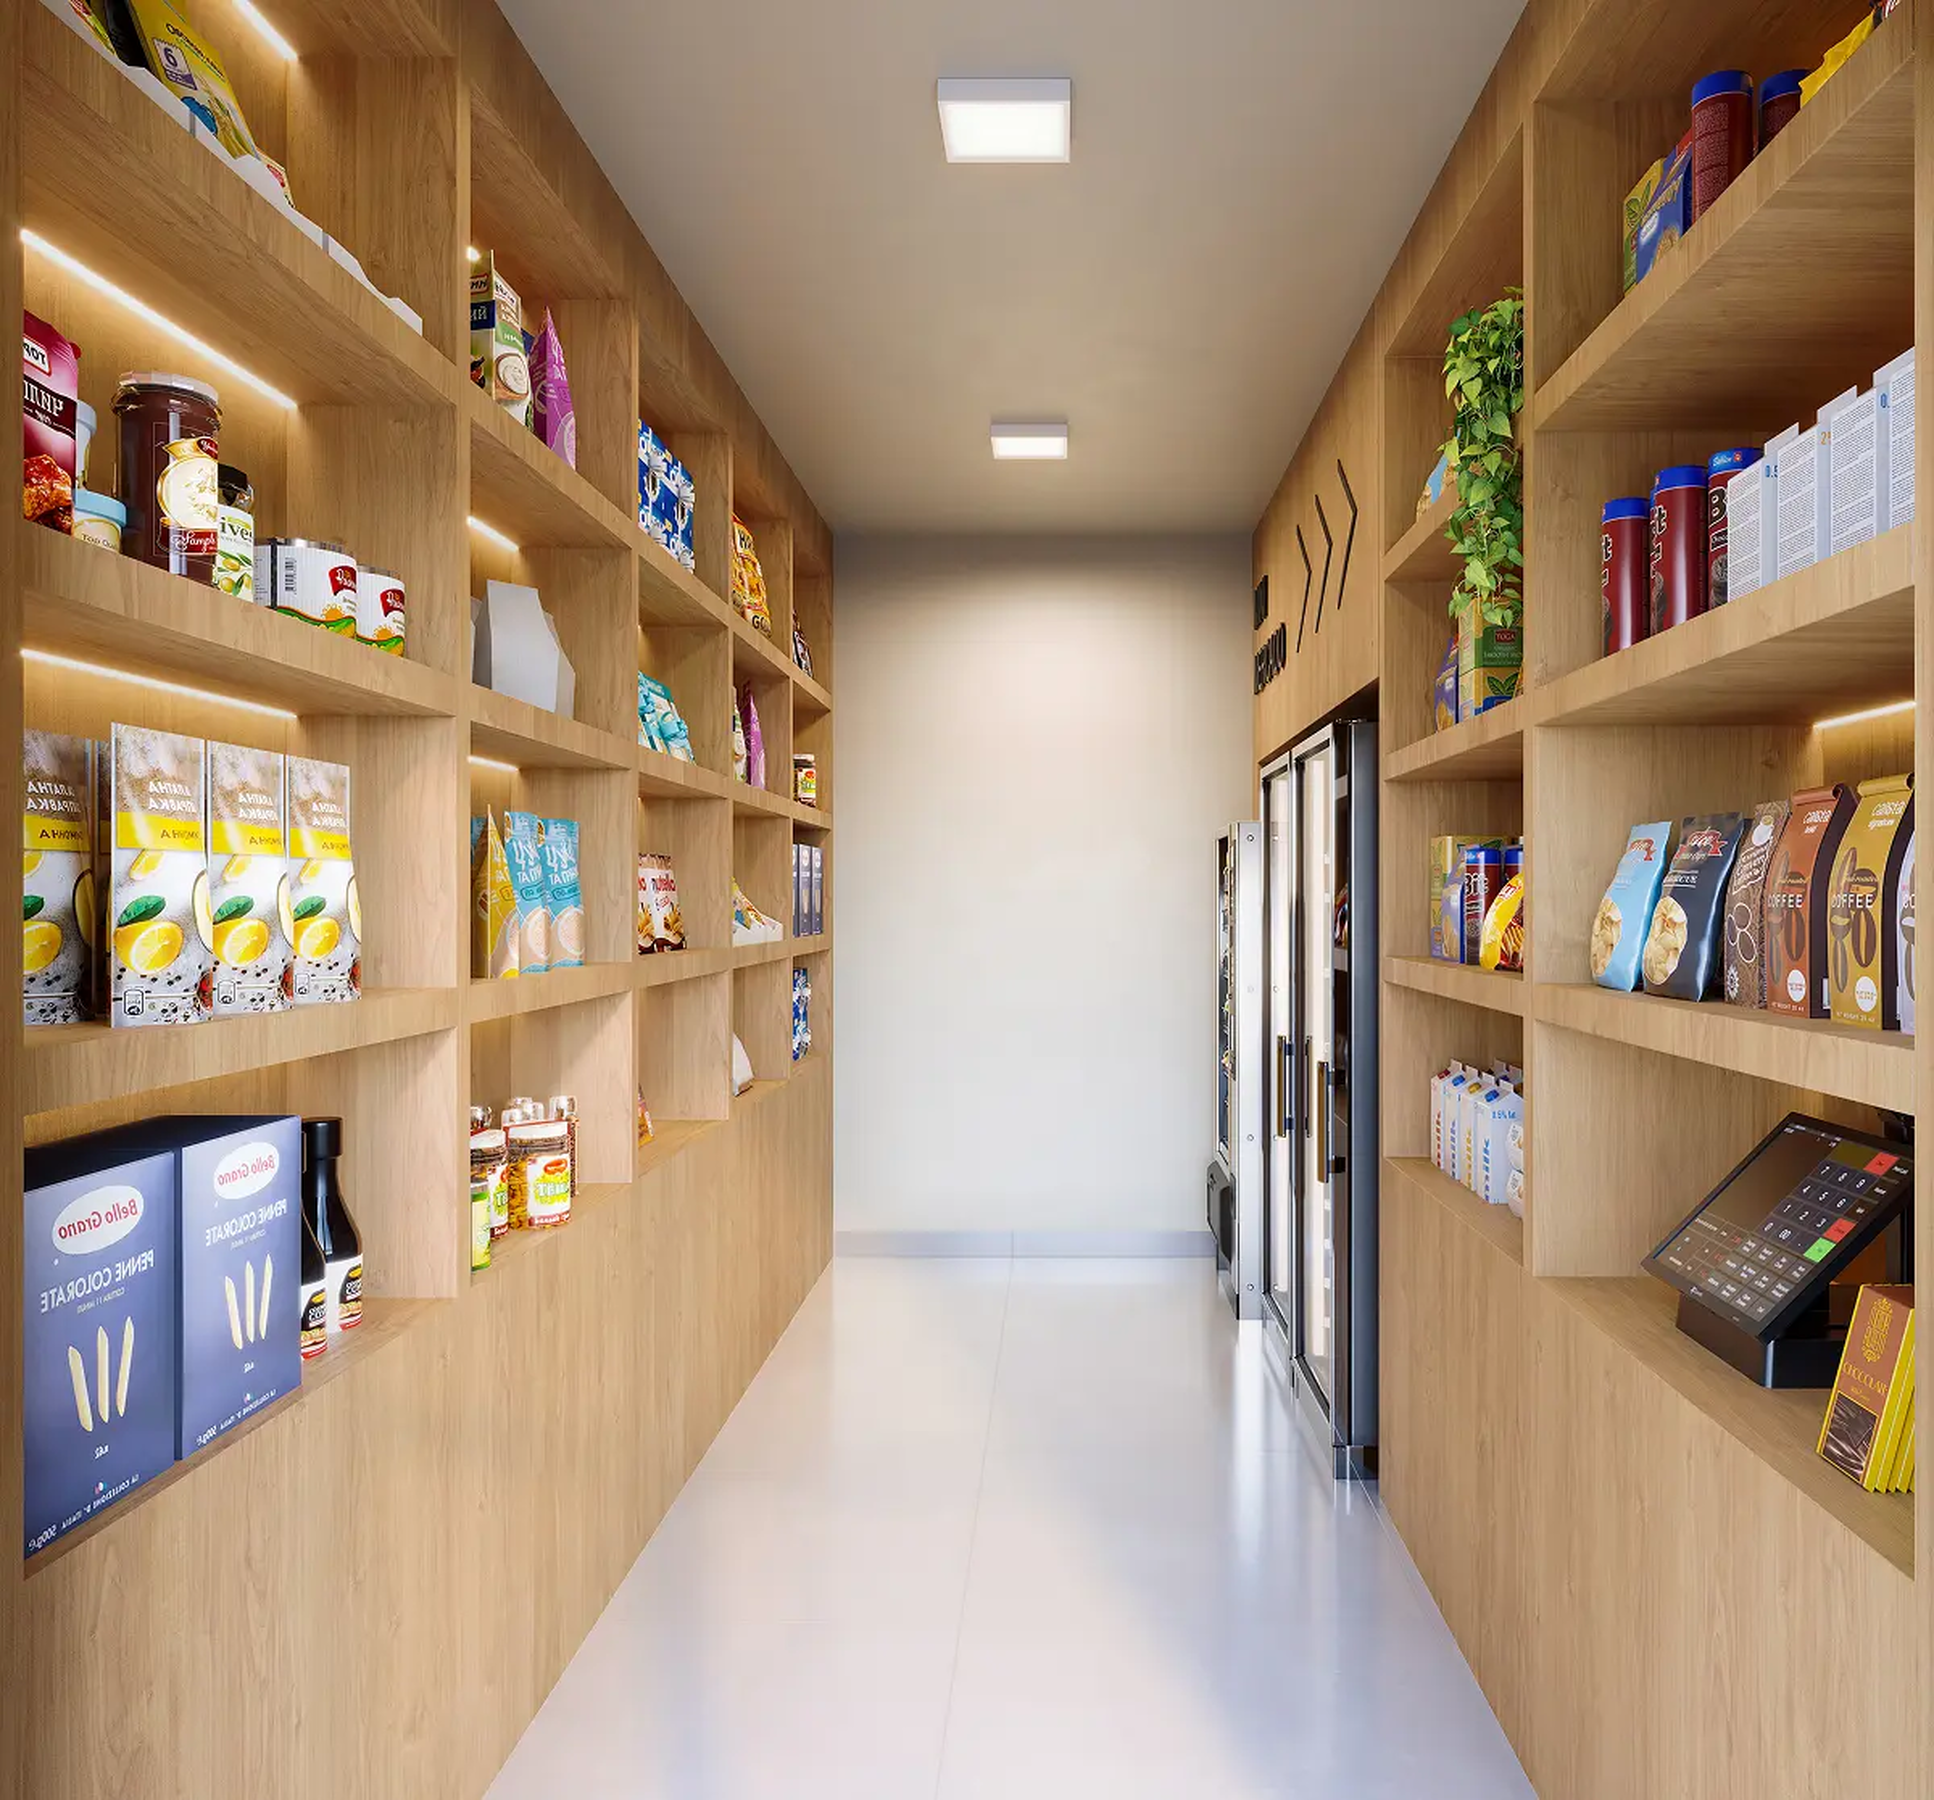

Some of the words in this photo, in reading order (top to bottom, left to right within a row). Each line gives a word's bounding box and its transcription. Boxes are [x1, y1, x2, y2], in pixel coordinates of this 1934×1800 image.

[163, 47, 178, 67] 6
[1767, 893, 1803, 908] COFFEE
[1831, 893, 1874, 909] COFFEE
[1821, 1165, 1830, 1175] 7
[1819, 1191, 1828, 1201] 5
[1799, 1211, 1809, 1220] 2
